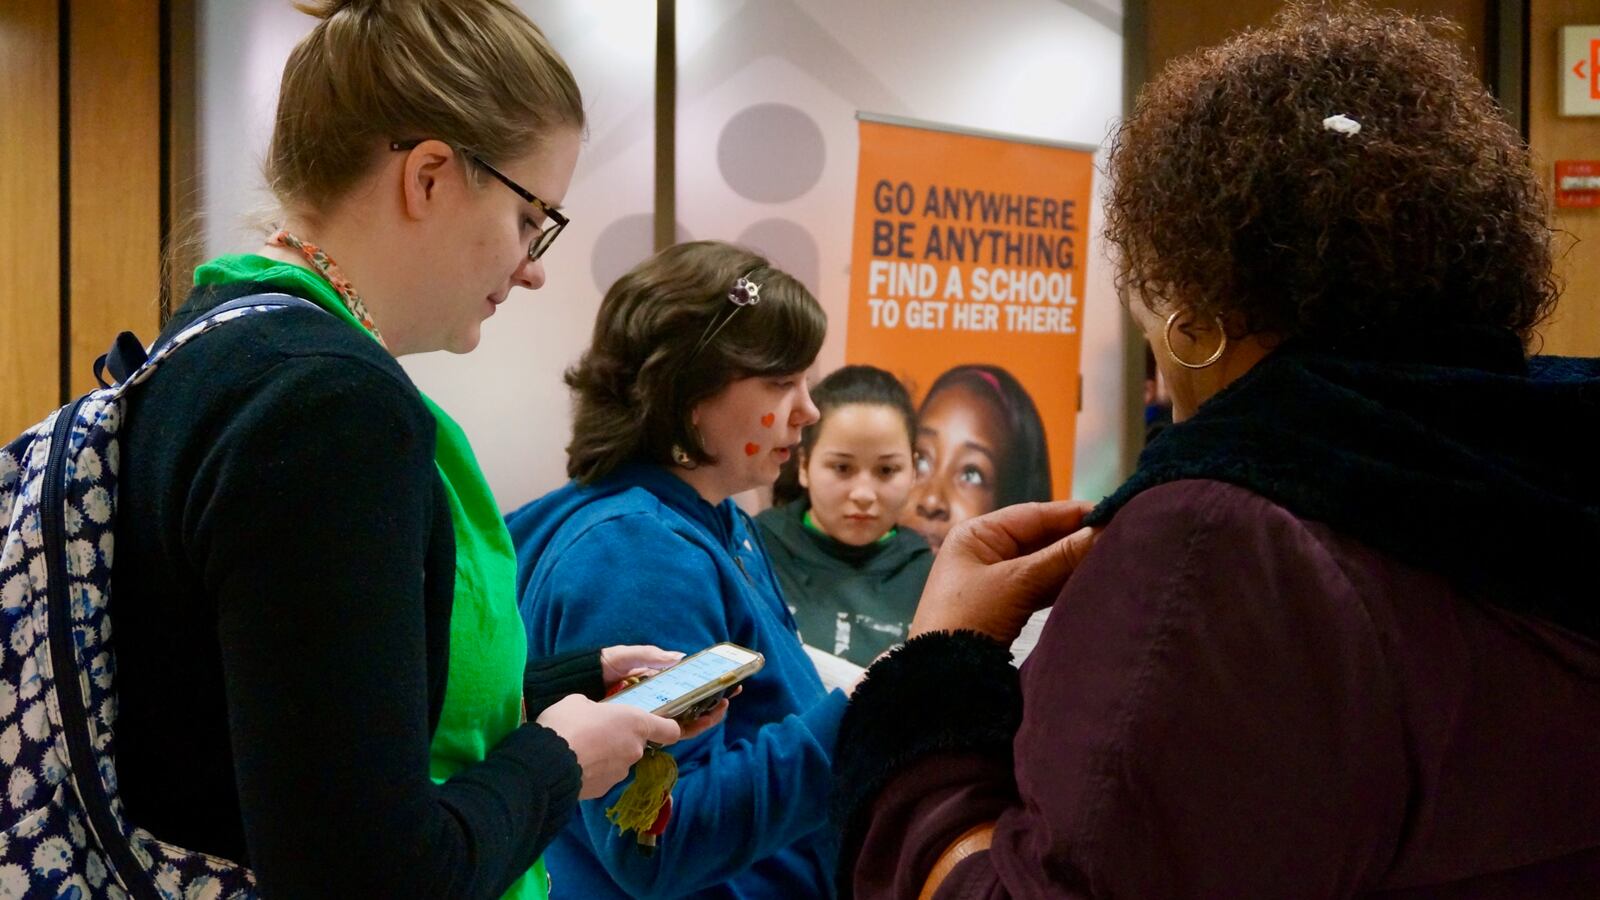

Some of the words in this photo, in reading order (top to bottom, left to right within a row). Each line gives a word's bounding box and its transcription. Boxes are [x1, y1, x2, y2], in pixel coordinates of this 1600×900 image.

[873, 179, 915, 216] GO
[872, 220, 916, 258] BE
[868, 260, 938, 298] FIND
[943, 265, 964, 300] A
[970, 267, 1077, 305] SCHOOL
[868, 298, 900, 328] TO
[905, 301, 948, 330] GET
[952, 302, 999, 331] HER
[1005, 305, 1076, 334] THERE.
